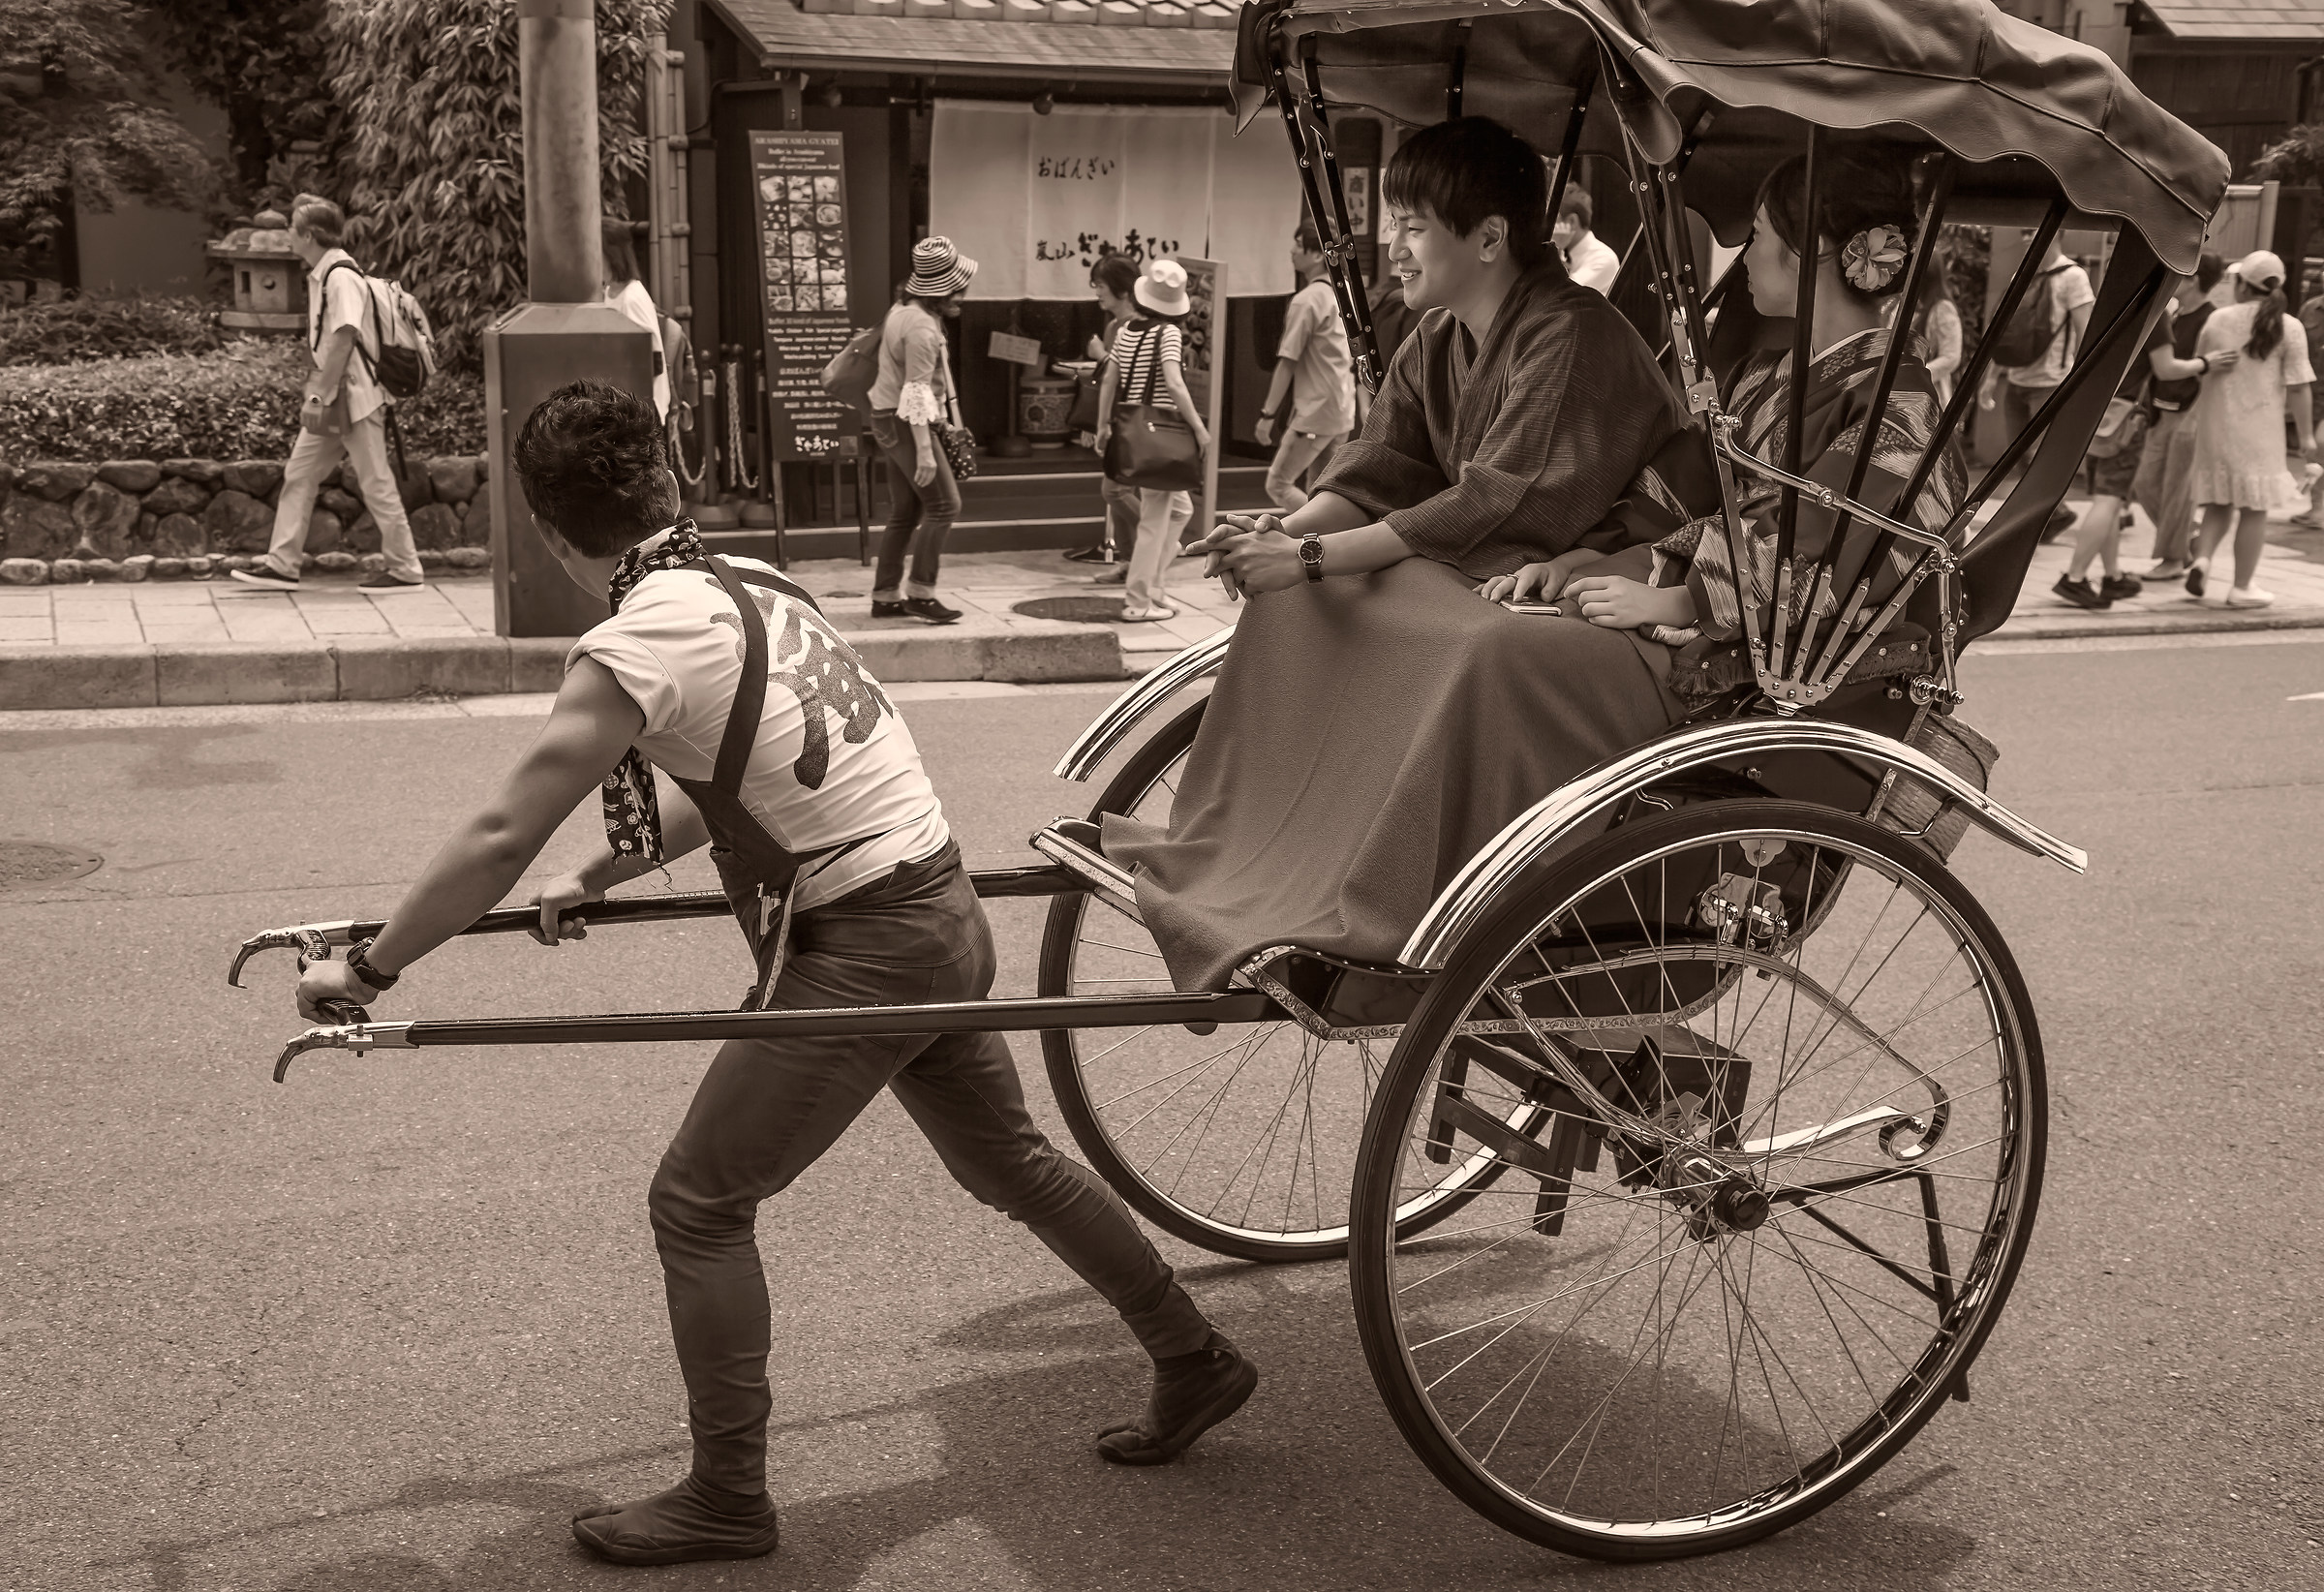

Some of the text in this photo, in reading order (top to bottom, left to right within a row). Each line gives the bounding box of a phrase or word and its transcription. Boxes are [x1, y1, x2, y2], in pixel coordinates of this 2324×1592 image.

[1038, 156, 1116, 180] おばんざい
[1349, 175, 1364, 231] 商い中
[795, 435, 840, 452] ぎゃあてい
